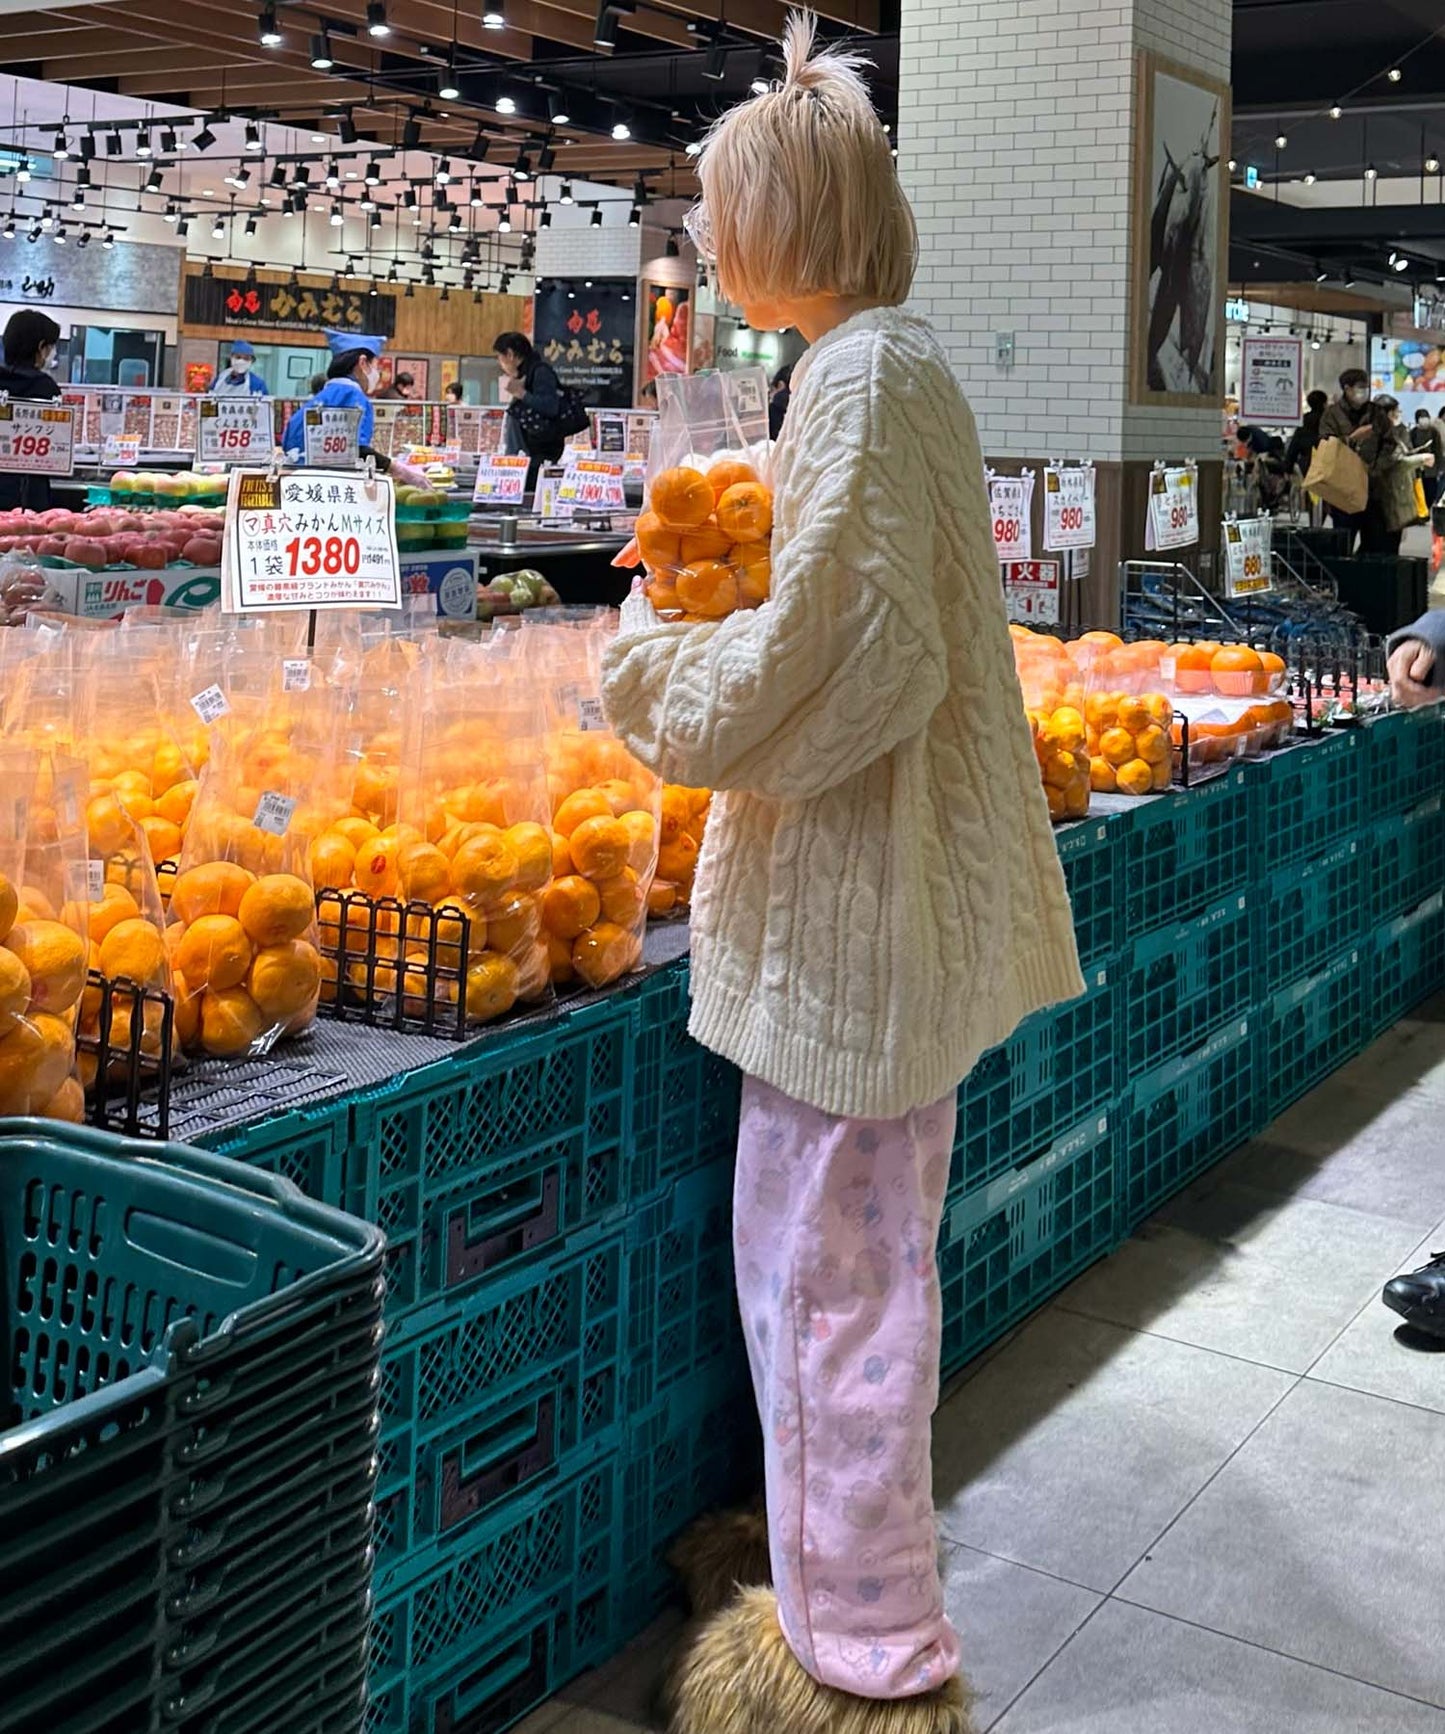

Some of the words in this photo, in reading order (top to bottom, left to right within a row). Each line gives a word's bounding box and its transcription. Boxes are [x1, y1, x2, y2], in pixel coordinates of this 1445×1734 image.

[269, 287, 363, 325] かみむら
[543, 338, 624, 364] かみむら
[717, 345, 738, 357] Food
[12, 435, 51, 457] 198
[219, 430, 251, 448] 158
[324, 437, 347, 454] 580
[285, 483, 358, 504] 愛媛県産
[1061, 507, 1083, 532] 980
[1171, 506, 1188, 529] 980
[994, 519, 1020, 543] 980
[285, 537, 360, 577] 1380
[103, 579, 147, 602] りんご
